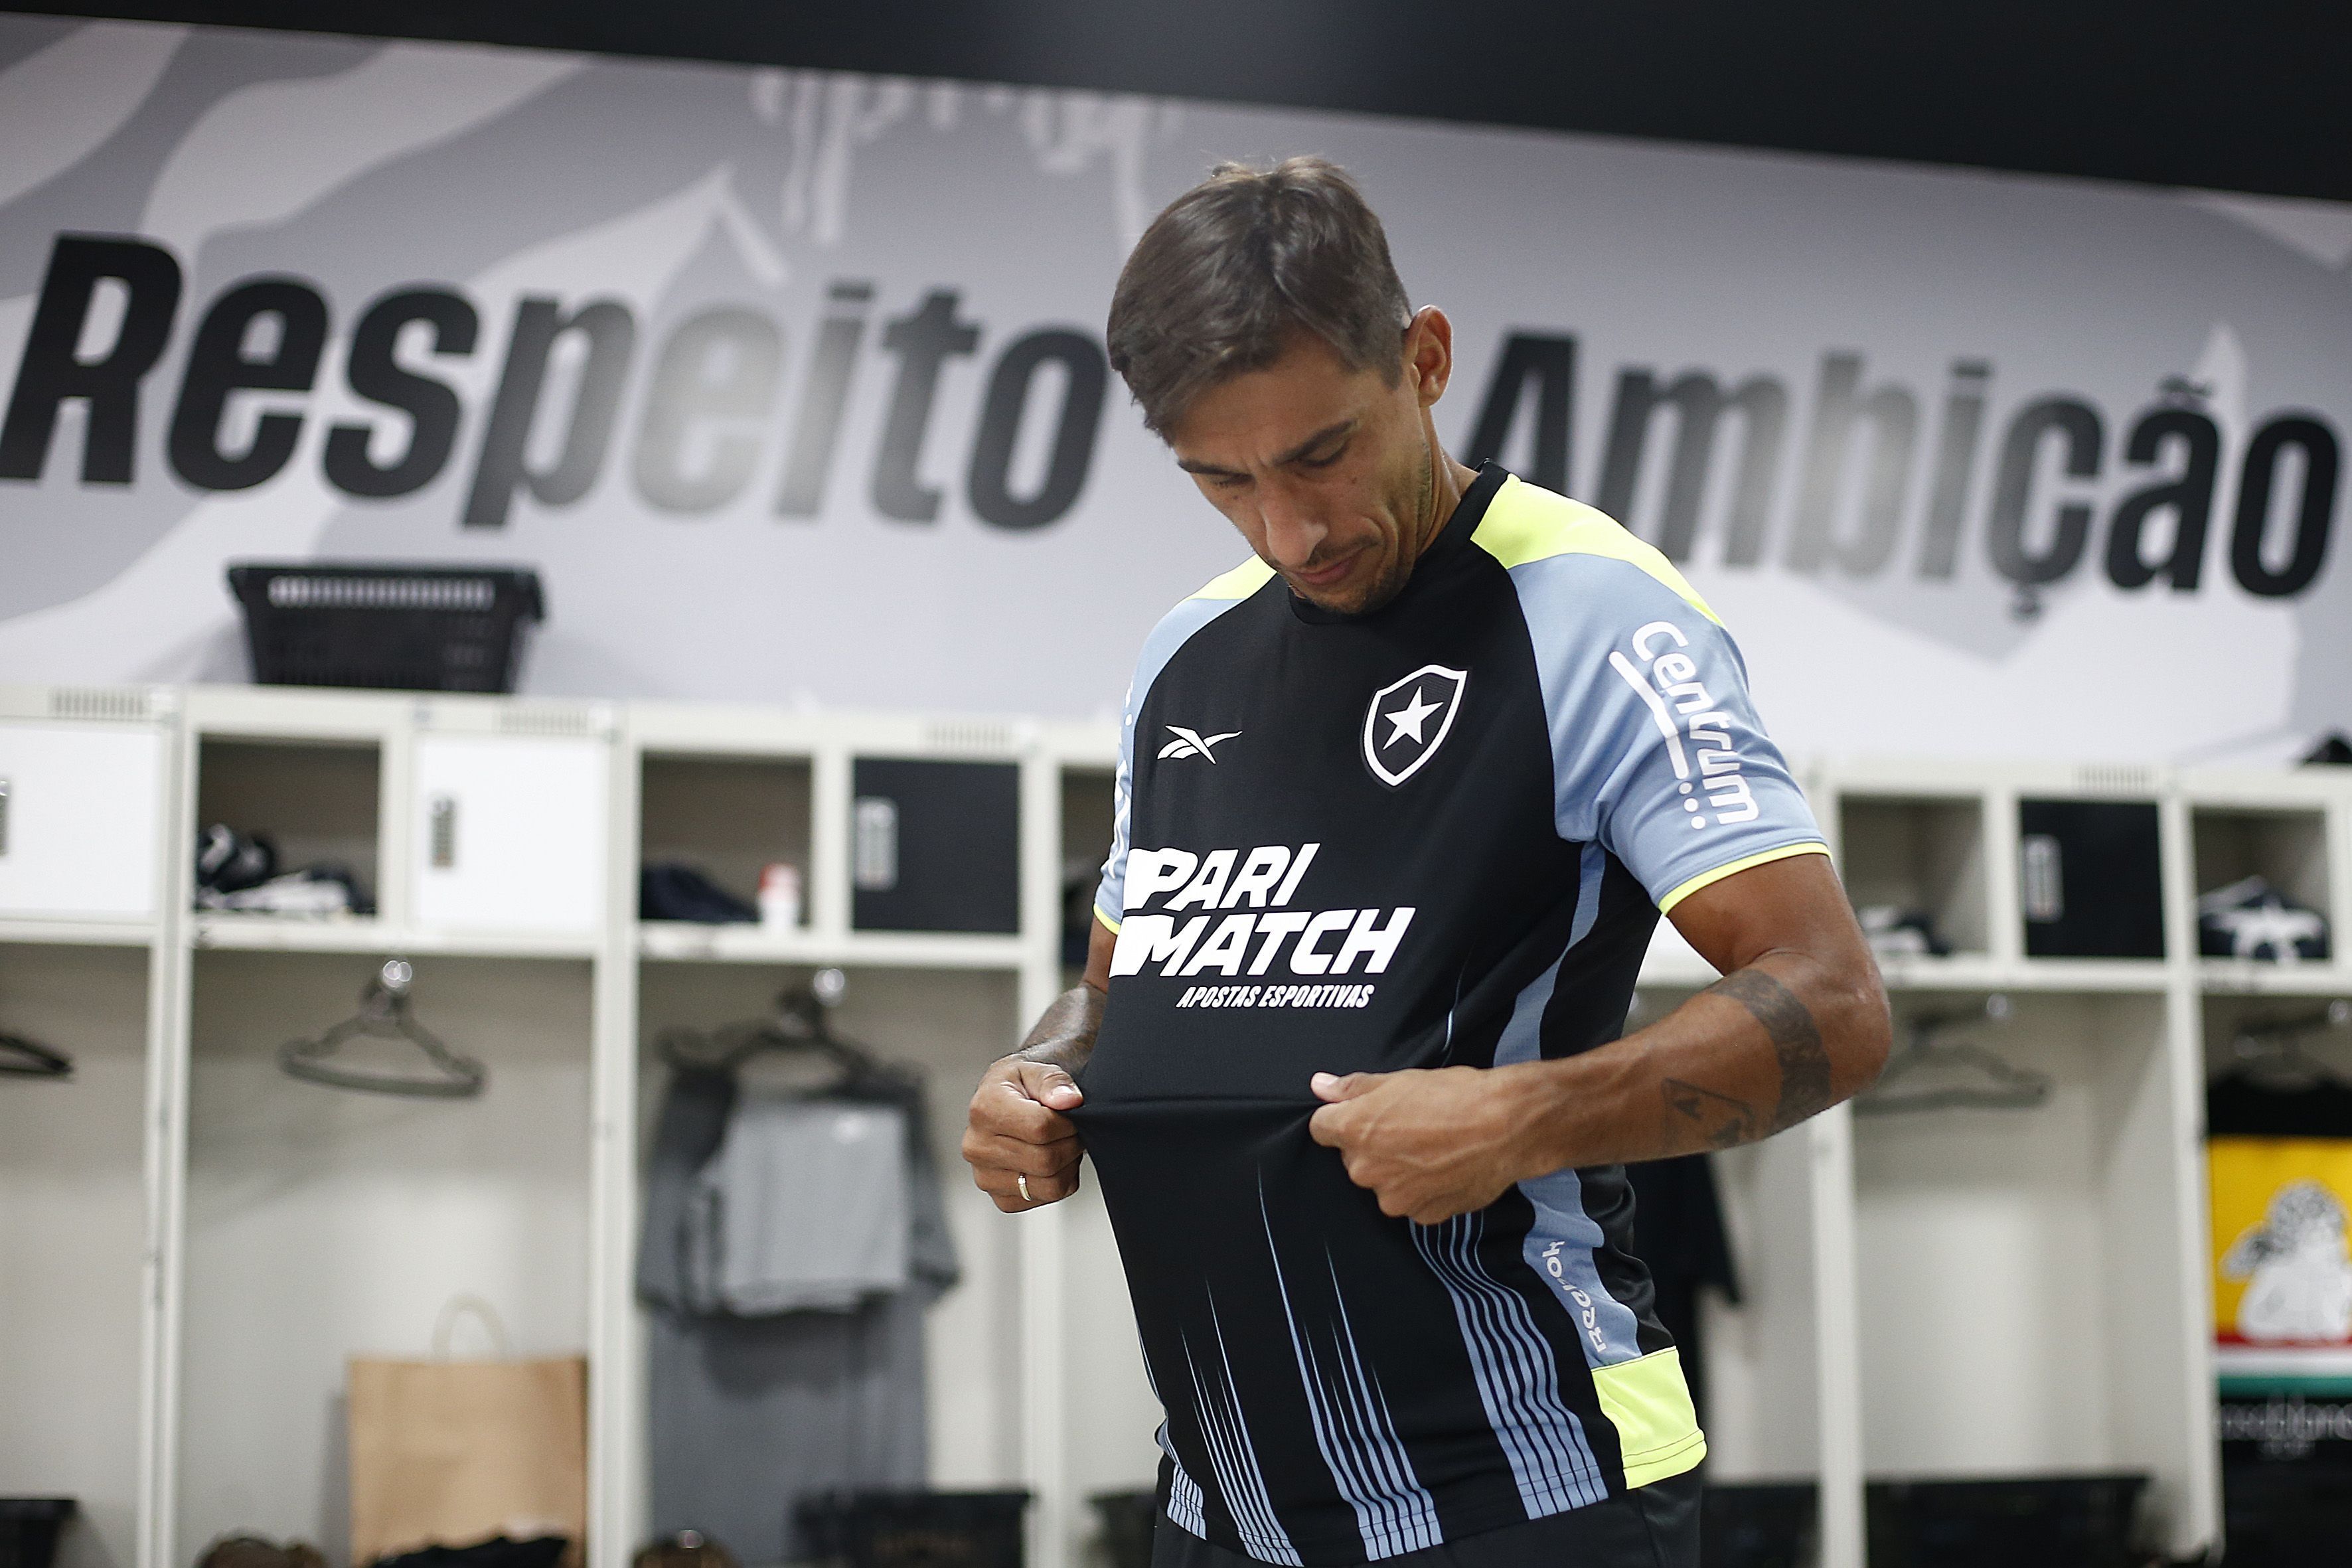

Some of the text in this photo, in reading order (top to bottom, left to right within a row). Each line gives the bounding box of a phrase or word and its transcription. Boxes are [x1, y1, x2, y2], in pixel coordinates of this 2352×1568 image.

[0, 232, 2340, 621] Respeito Ambição
[1631, 621, 1759, 826] Centrum
[1123, 843, 1320, 911] PARI
[1109, 907, 1416, 979] MATCH
[1176, 984, 1375, 1008] APOSTAS ESPORTIVAS
